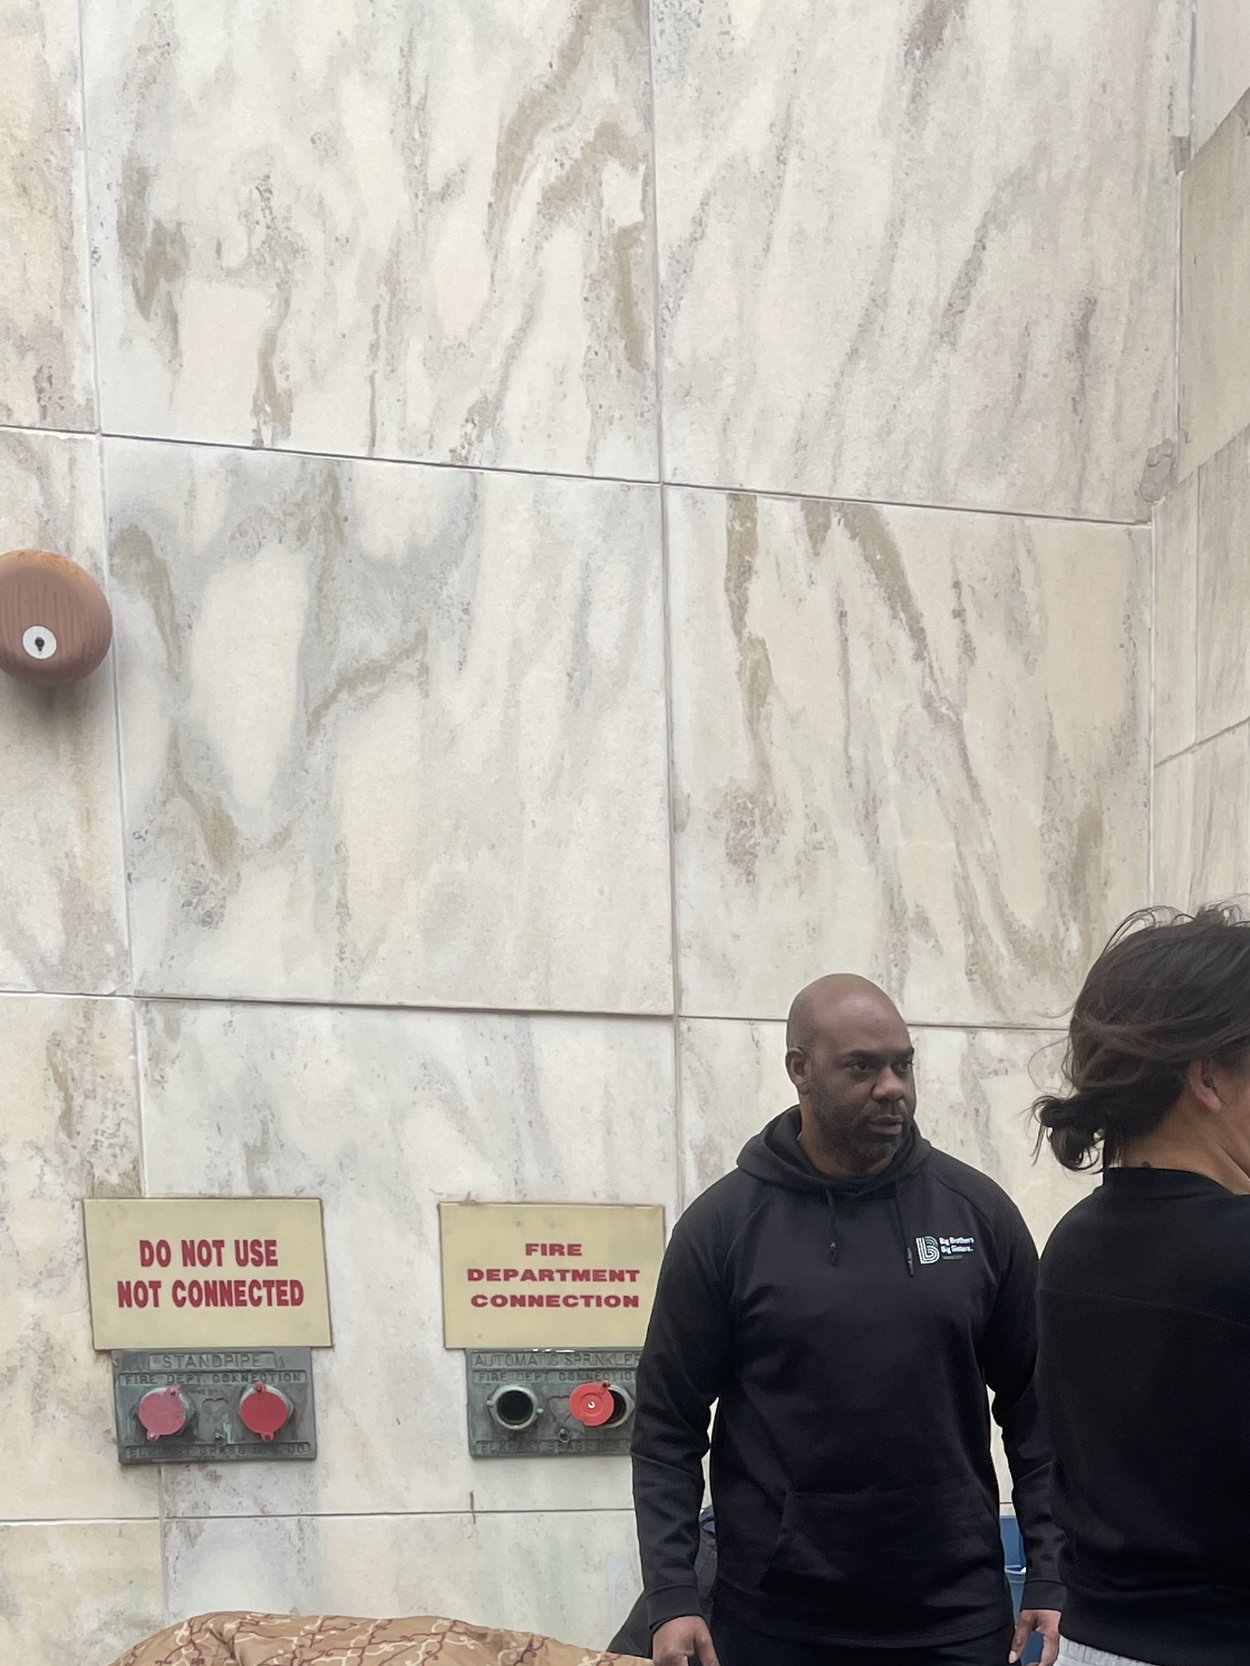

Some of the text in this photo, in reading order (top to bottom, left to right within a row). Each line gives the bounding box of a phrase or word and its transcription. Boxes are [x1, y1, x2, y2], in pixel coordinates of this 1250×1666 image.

[139, 1239, 278, 1267] DO NOT USE
[525, 1243, 583, 1256] FIRE
[467, 1269, 640, 1282] DEPARTMENT
[117, 1279, 304, 1308] NOT CONNECTED
[470, 1294, 640, 1308] CONNECTION
[162, 1354, 263, 1369] STANDPIPE
[474, 1353, 559, 1367] AUTOMATIC
[125, 1374, 157, 1385] FIRE
[212, 1371, 302, 1384] CONNECTION
[479, 1372, 506, 1382] FIRE
[558, 1370, 635, 1382] CONNECTIO
